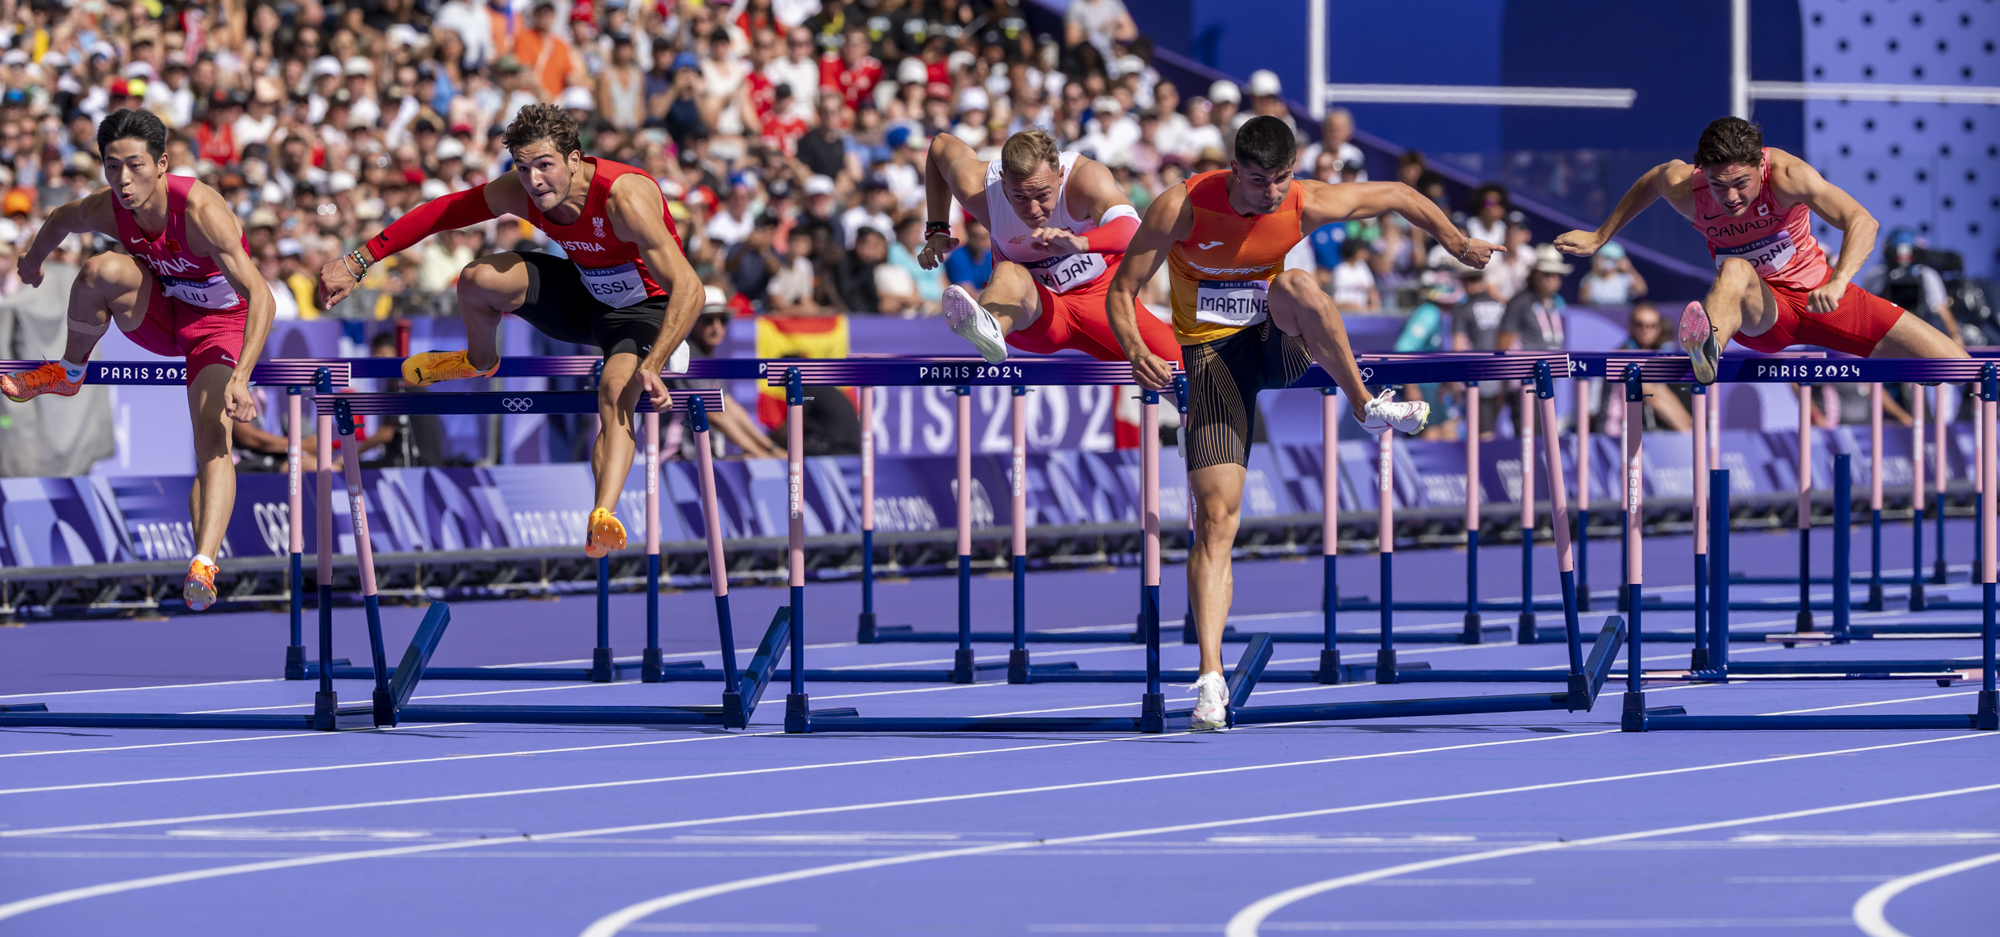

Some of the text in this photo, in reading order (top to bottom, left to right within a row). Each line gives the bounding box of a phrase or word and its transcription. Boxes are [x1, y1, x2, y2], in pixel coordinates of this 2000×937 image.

[1706, 217, 1781, 237] CANADA
[558, 240, 606, 252] USTRIA
[1746, 240, 1792, 269] ORNE
[182, 290, 208, 303] LIU
[1200, 296, 1269, 313] MARTINE
[155, 367, 187, 380] 202
[976, 366, 1023, 378] 2024
[1570, 360, 1587, 372] 24
[1814, 365, 1860, 377] 2024
[873, 386, 1115, 455] RIS 202
[1380, 452, 1390, 491] MONDO
[789, 475, 800, 519] MONDO
[1628, 469, 1639, 513] MONDO
[349, 495, 364, 536] MONDO
